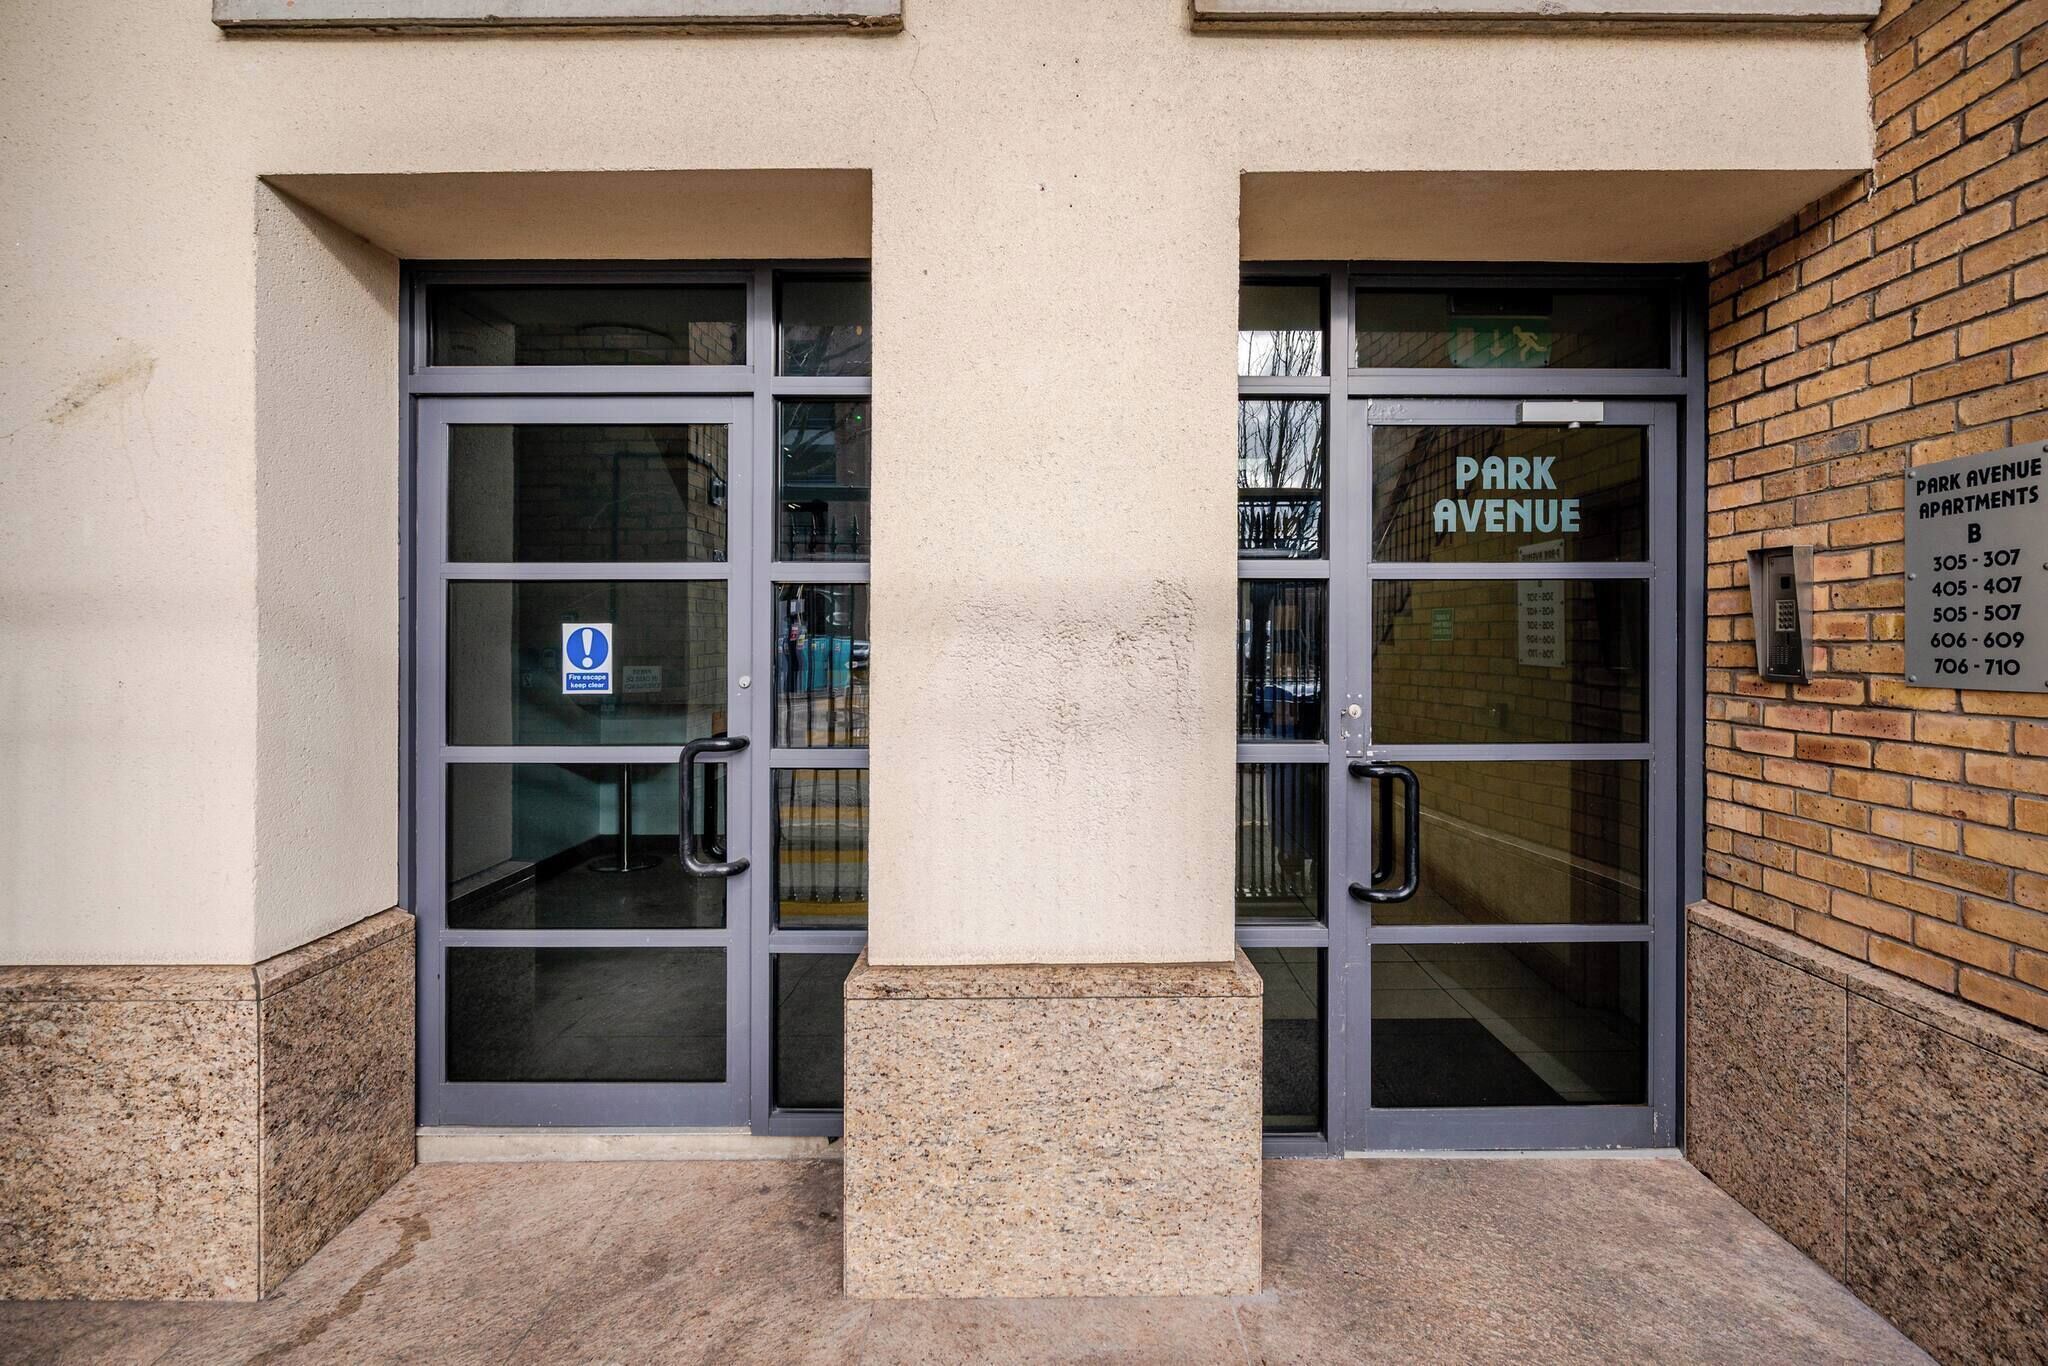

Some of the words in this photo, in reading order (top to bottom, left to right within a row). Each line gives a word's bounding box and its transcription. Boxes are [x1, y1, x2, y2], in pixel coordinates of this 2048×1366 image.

[1456, 455, 1557, 490] PARK
[1916, 472, 1961, 496] PARK
[1966, 458, 2042, 488] AVENUE
[1919, 485, 2039, 519] APARTMENTS
[1433, 498, 1580, 533] AVENUE
[1967, 523, 1982, 544] B
[1933, 554, 1967, 572] 305
[1983, 548, 2021, 568] 307
[1931, 580, 1967, 597] 405
[1983, 576, 2022, 594] 407
[1932, 606, 1967, 623] 505
[1983, 604, 2021, 622] 507
[1930, 632, 1967, 649] 606
[1983, 631, 2025, 649] 609
[1934, 658, 1969, 674] 706
[1984, 658, 2020, 676] 710
[582, 674, 606, 682] escape
